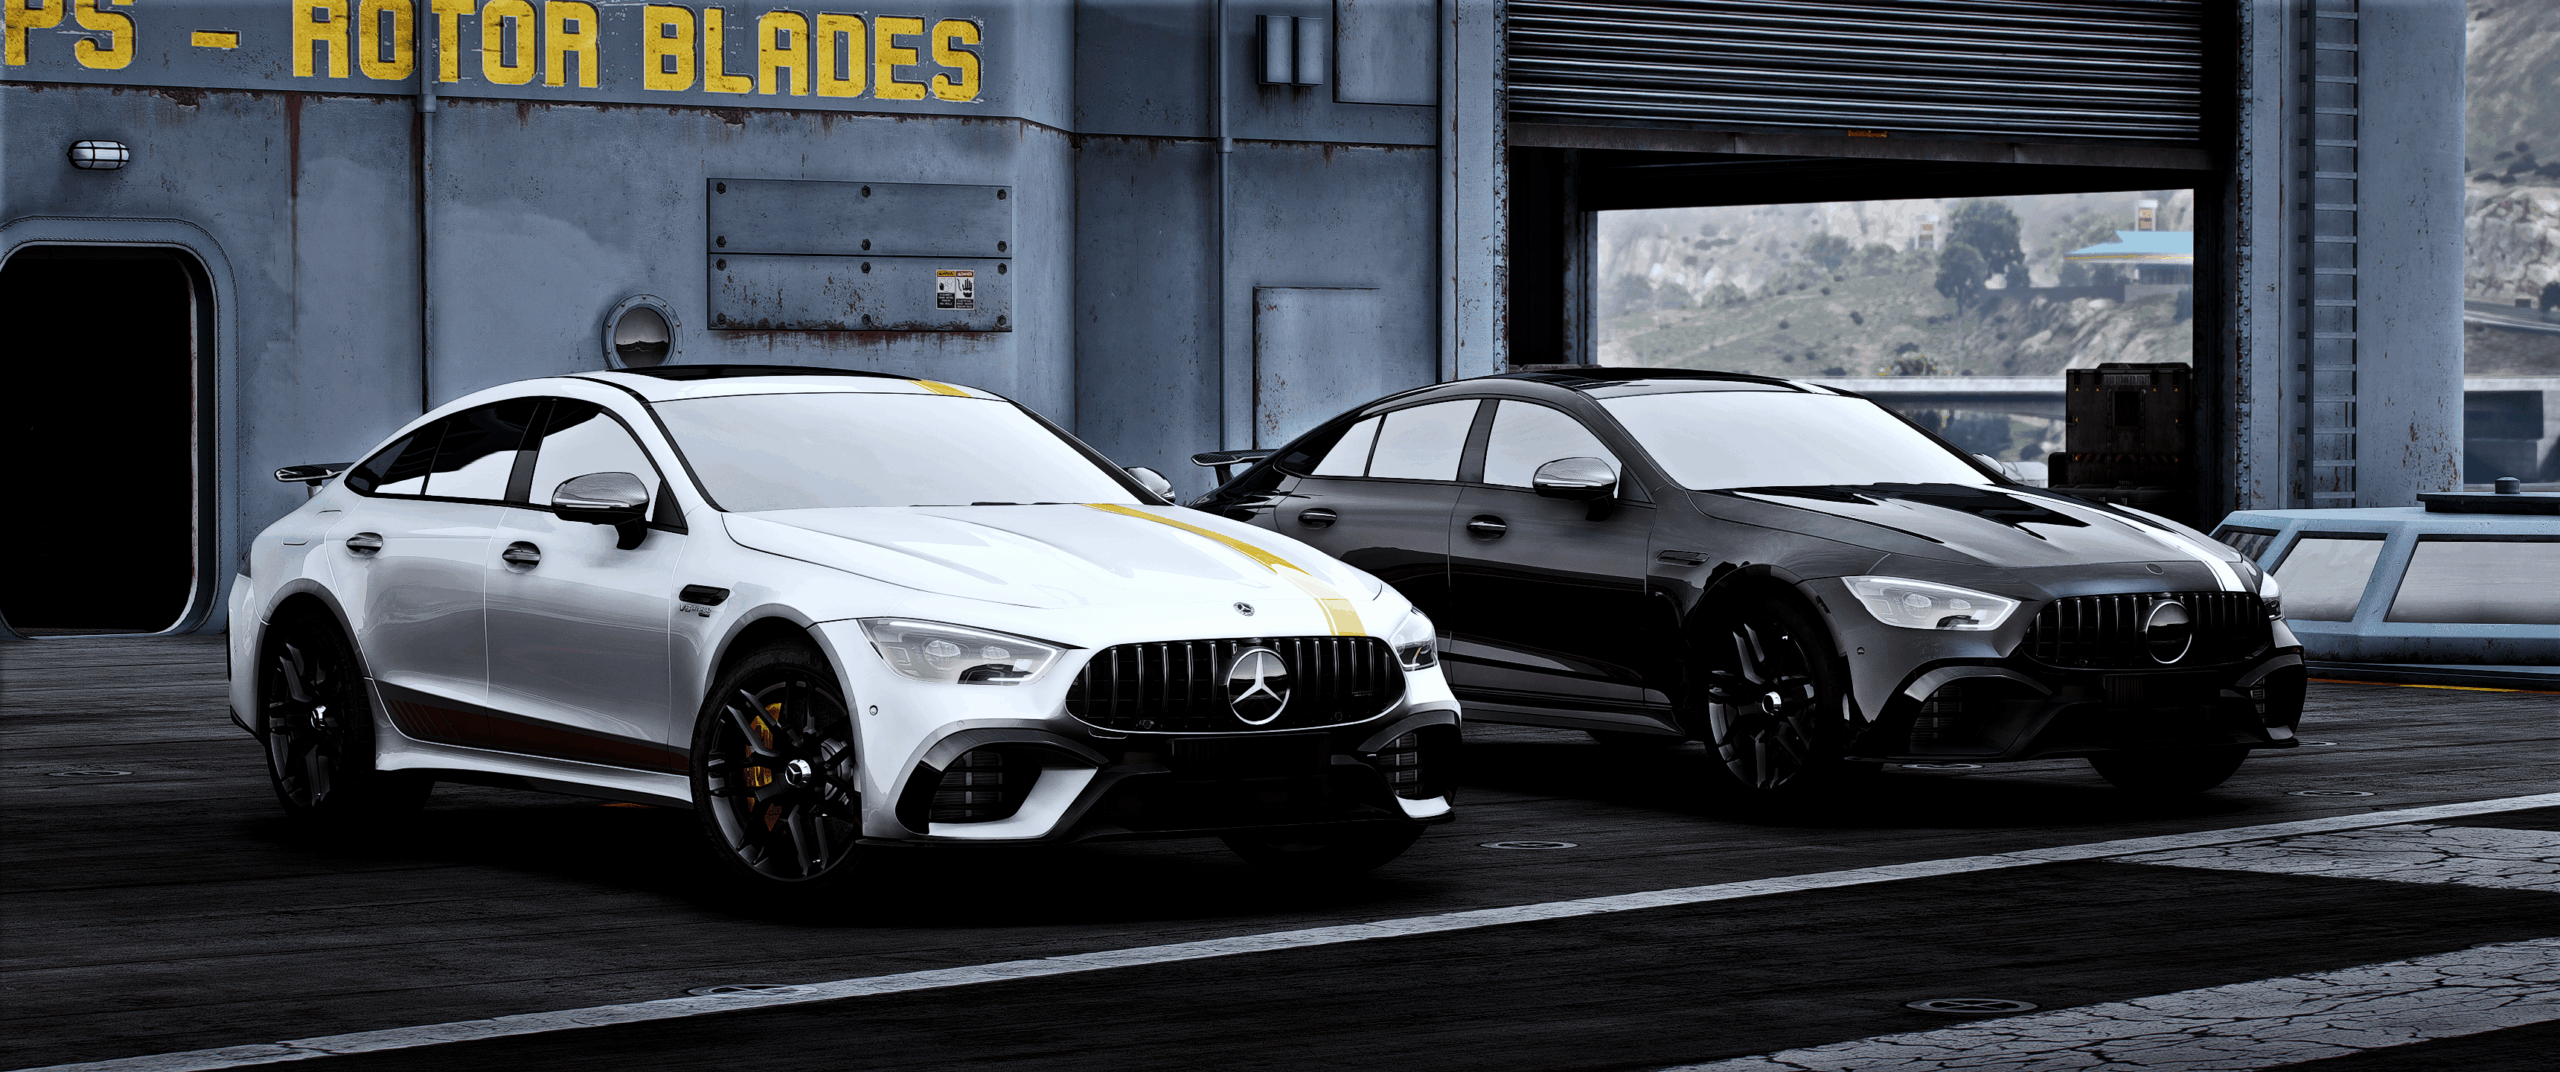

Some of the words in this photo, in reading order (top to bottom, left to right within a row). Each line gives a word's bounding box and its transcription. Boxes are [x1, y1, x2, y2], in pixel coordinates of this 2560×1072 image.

[4, 0, 136, 69] PS
[293, 0, 600, 88] ROTOR
[643, 4, 982, 101] BLADES
